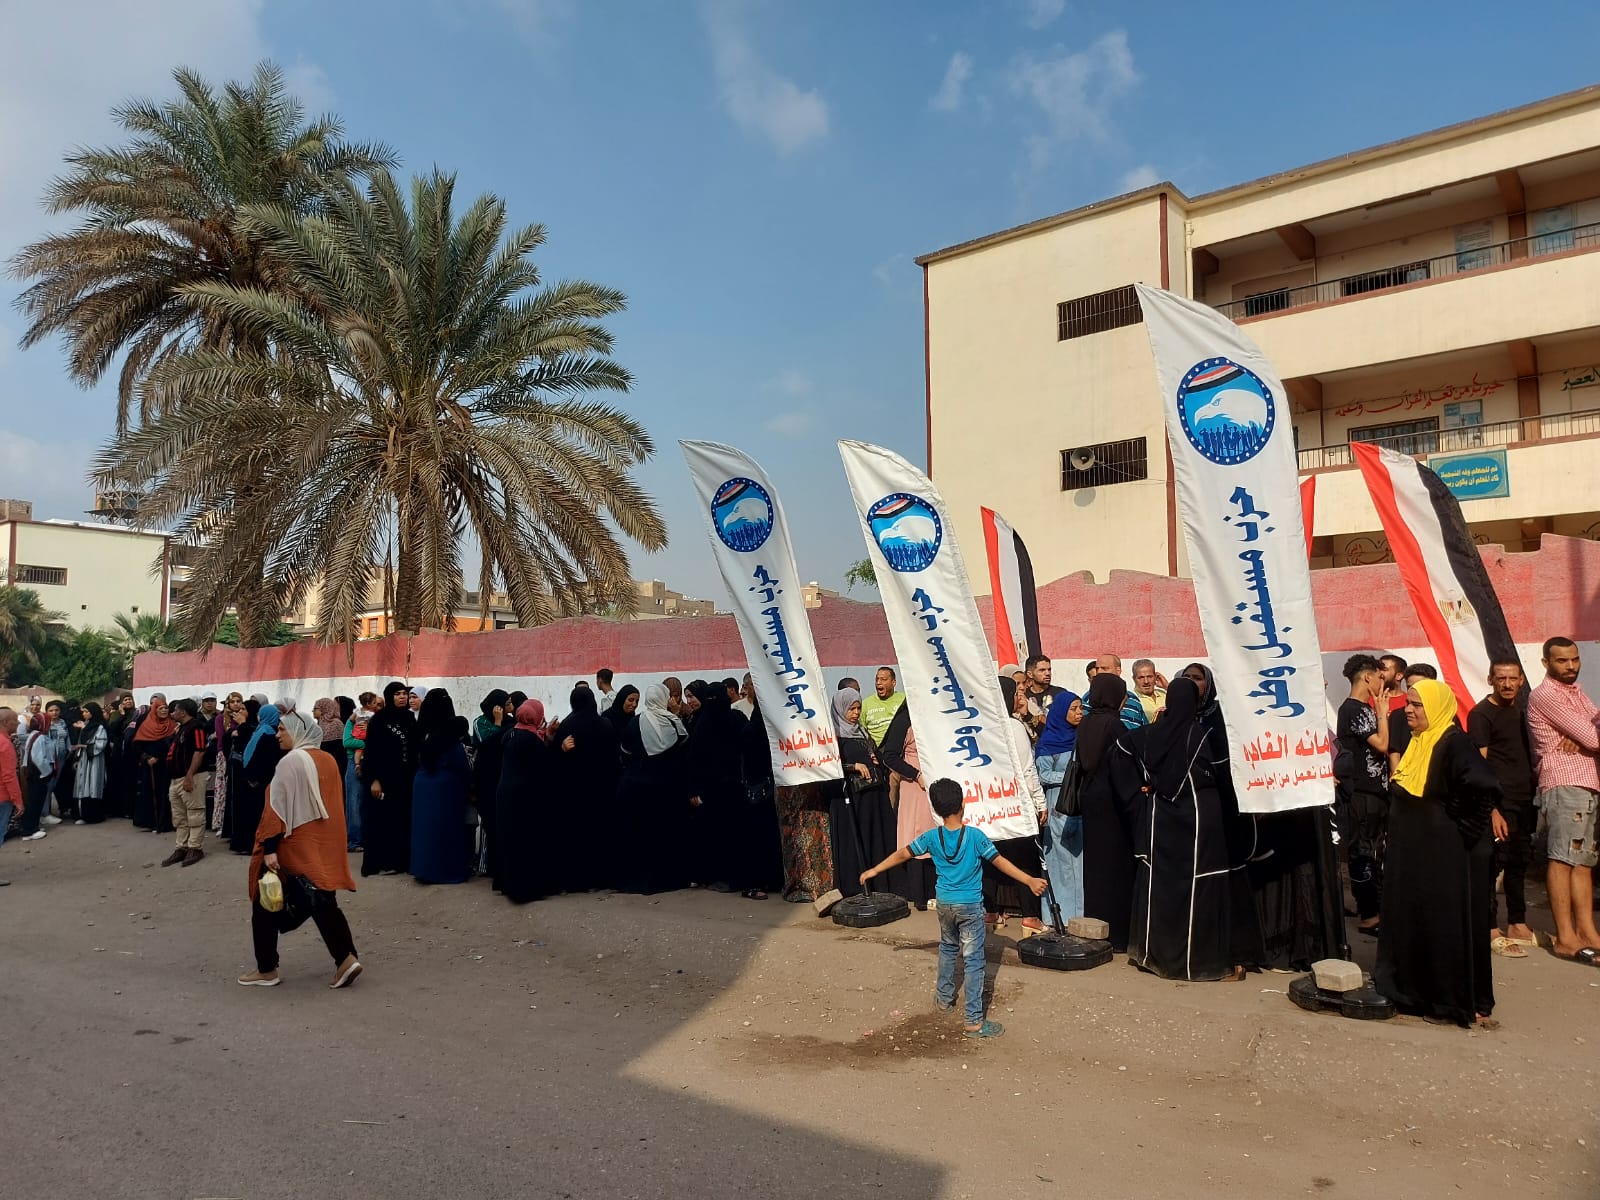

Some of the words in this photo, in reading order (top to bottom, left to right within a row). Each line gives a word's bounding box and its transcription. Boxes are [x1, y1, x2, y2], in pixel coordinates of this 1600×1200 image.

[1223, 486, 1276, 542] حزب
[748, 564, 783, 604] حزب
[1231, 549, 1292, 659] مستقبل
[911, 587, 950, 631] حزب
[761, 606, 806, 680] مستقبل
[783, 683, 816, 719] وطن
[930, 636, 979, 720] مستقبل
[1246, 665, 1306, 718] وطن
[947, 725, 992, 768] وطن
[1295, 728, 1330, 757] مانه
